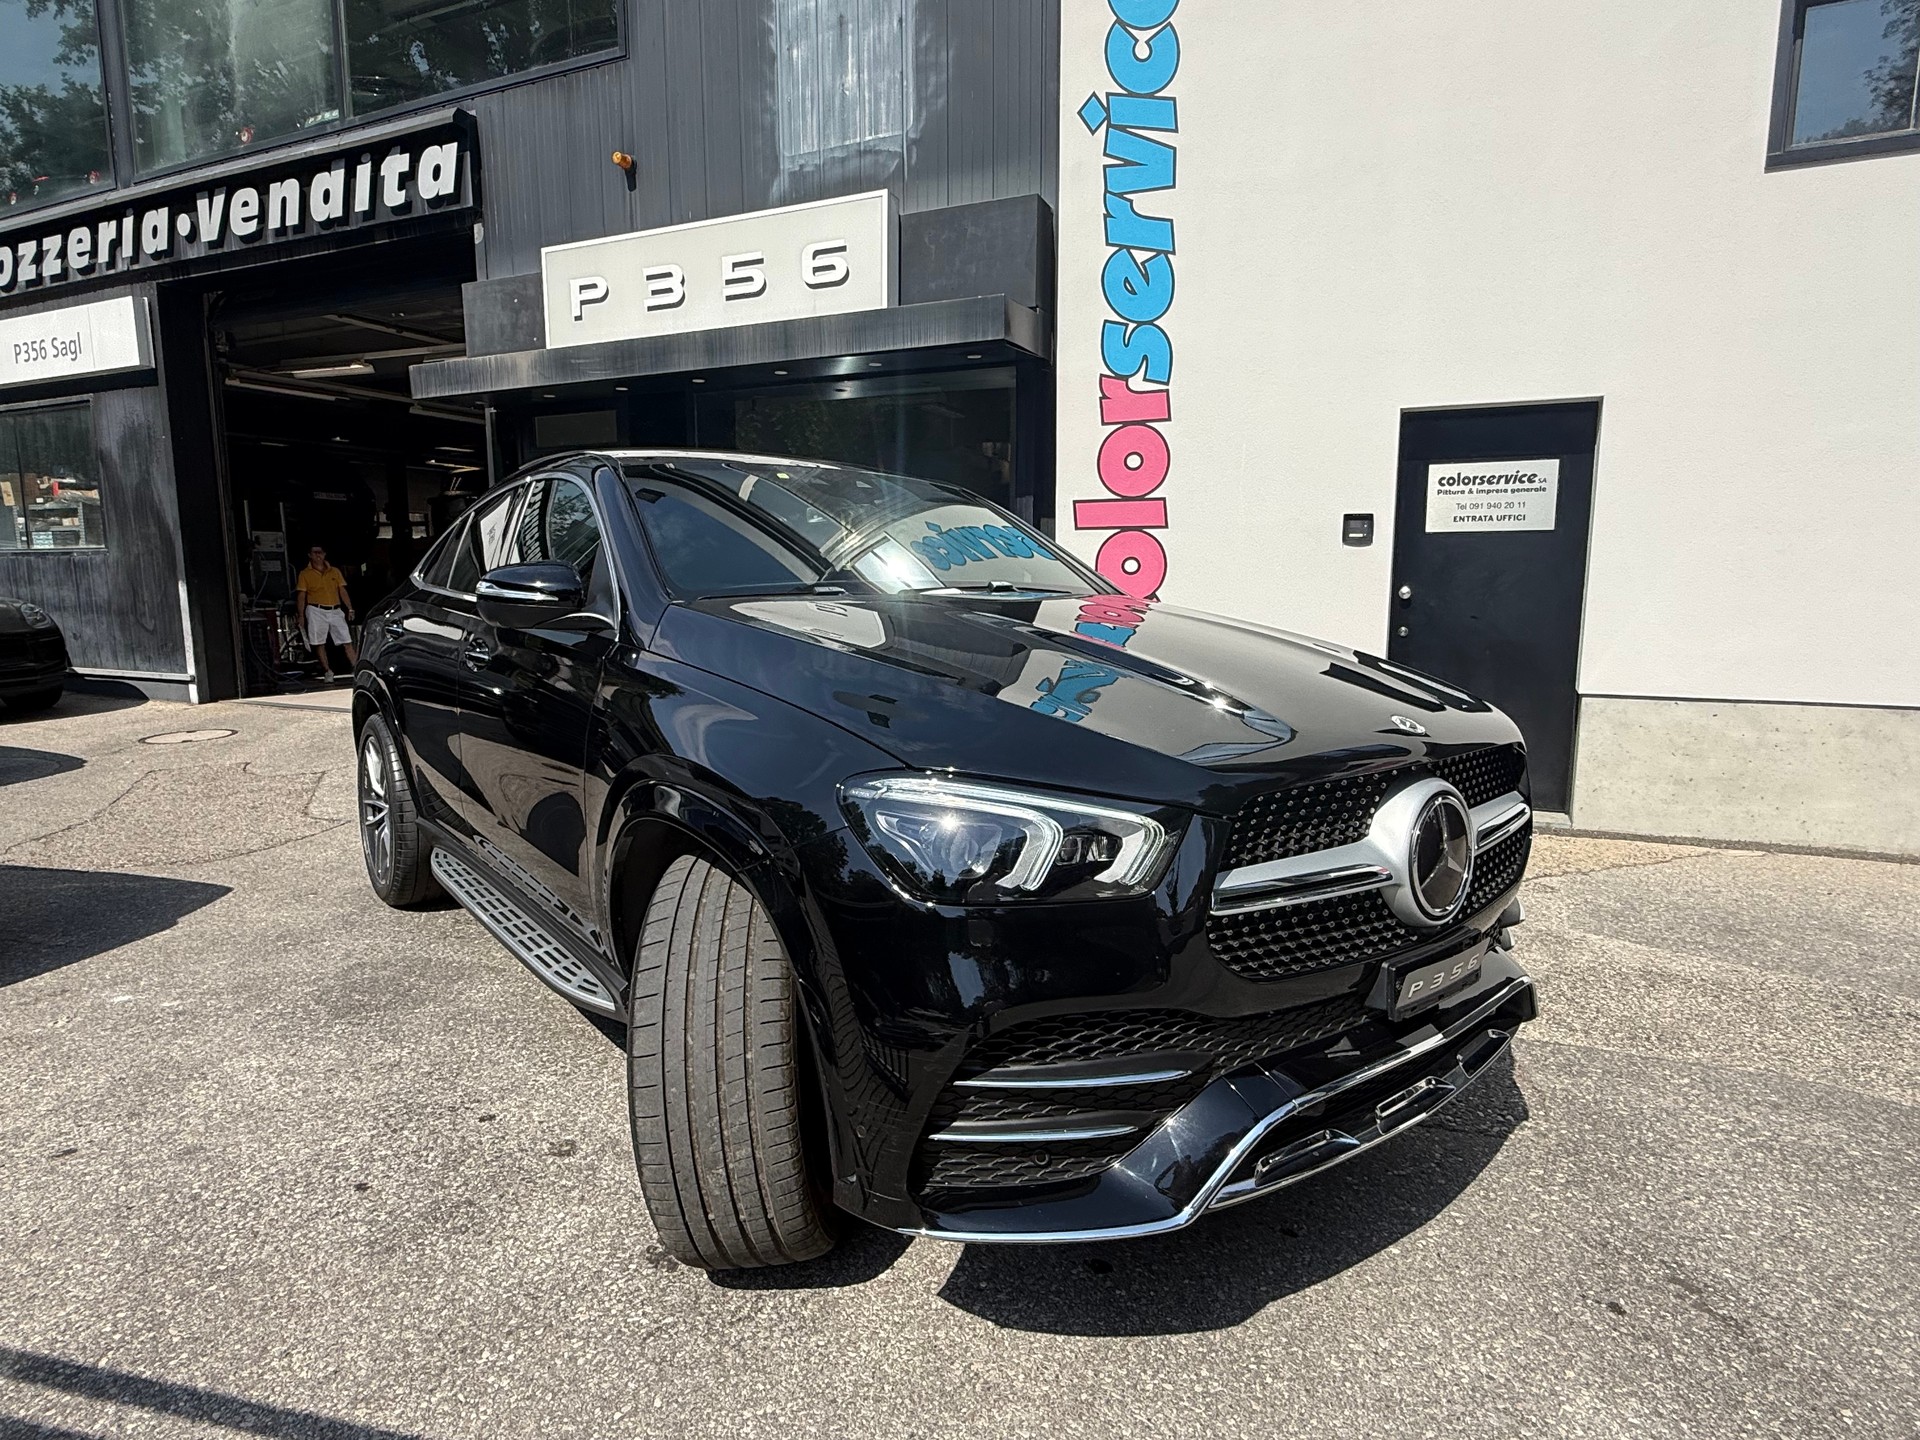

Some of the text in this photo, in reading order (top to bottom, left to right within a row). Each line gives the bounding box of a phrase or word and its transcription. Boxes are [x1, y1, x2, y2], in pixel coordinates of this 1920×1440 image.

[1075, 0, 1181, 602] olorservic
[13, 331, 82, 364] P356 Sagl
[1437, 469, 1538, 487] colorservice
[1467, 487, 1474, 495] &
[1476, 487, 1508, 495] impresa
[1510, 485, 1547, 494] generale
[1456, 501, 1526, 510] Tel 091 940 20 11
[1453, 514, 1526, 523] ENTRATA UFFICI
